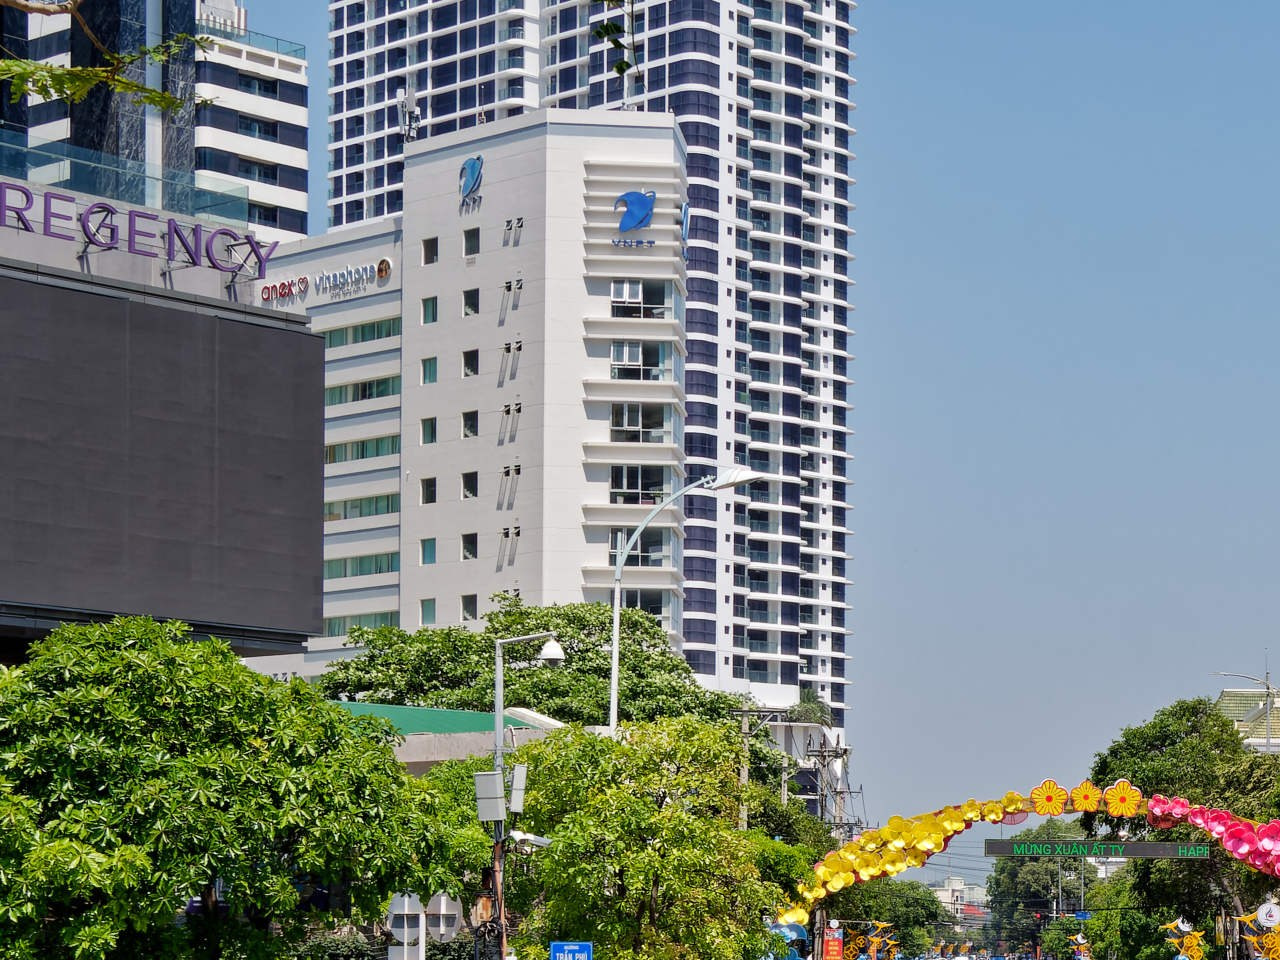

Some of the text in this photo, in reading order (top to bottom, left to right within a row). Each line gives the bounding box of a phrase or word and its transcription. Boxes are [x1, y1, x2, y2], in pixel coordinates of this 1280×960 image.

[0, 181, 280, 280] REGENCY
[611, 239, 656, 248] VNPT
[1055, 842, 1088, 856] XUÂN
